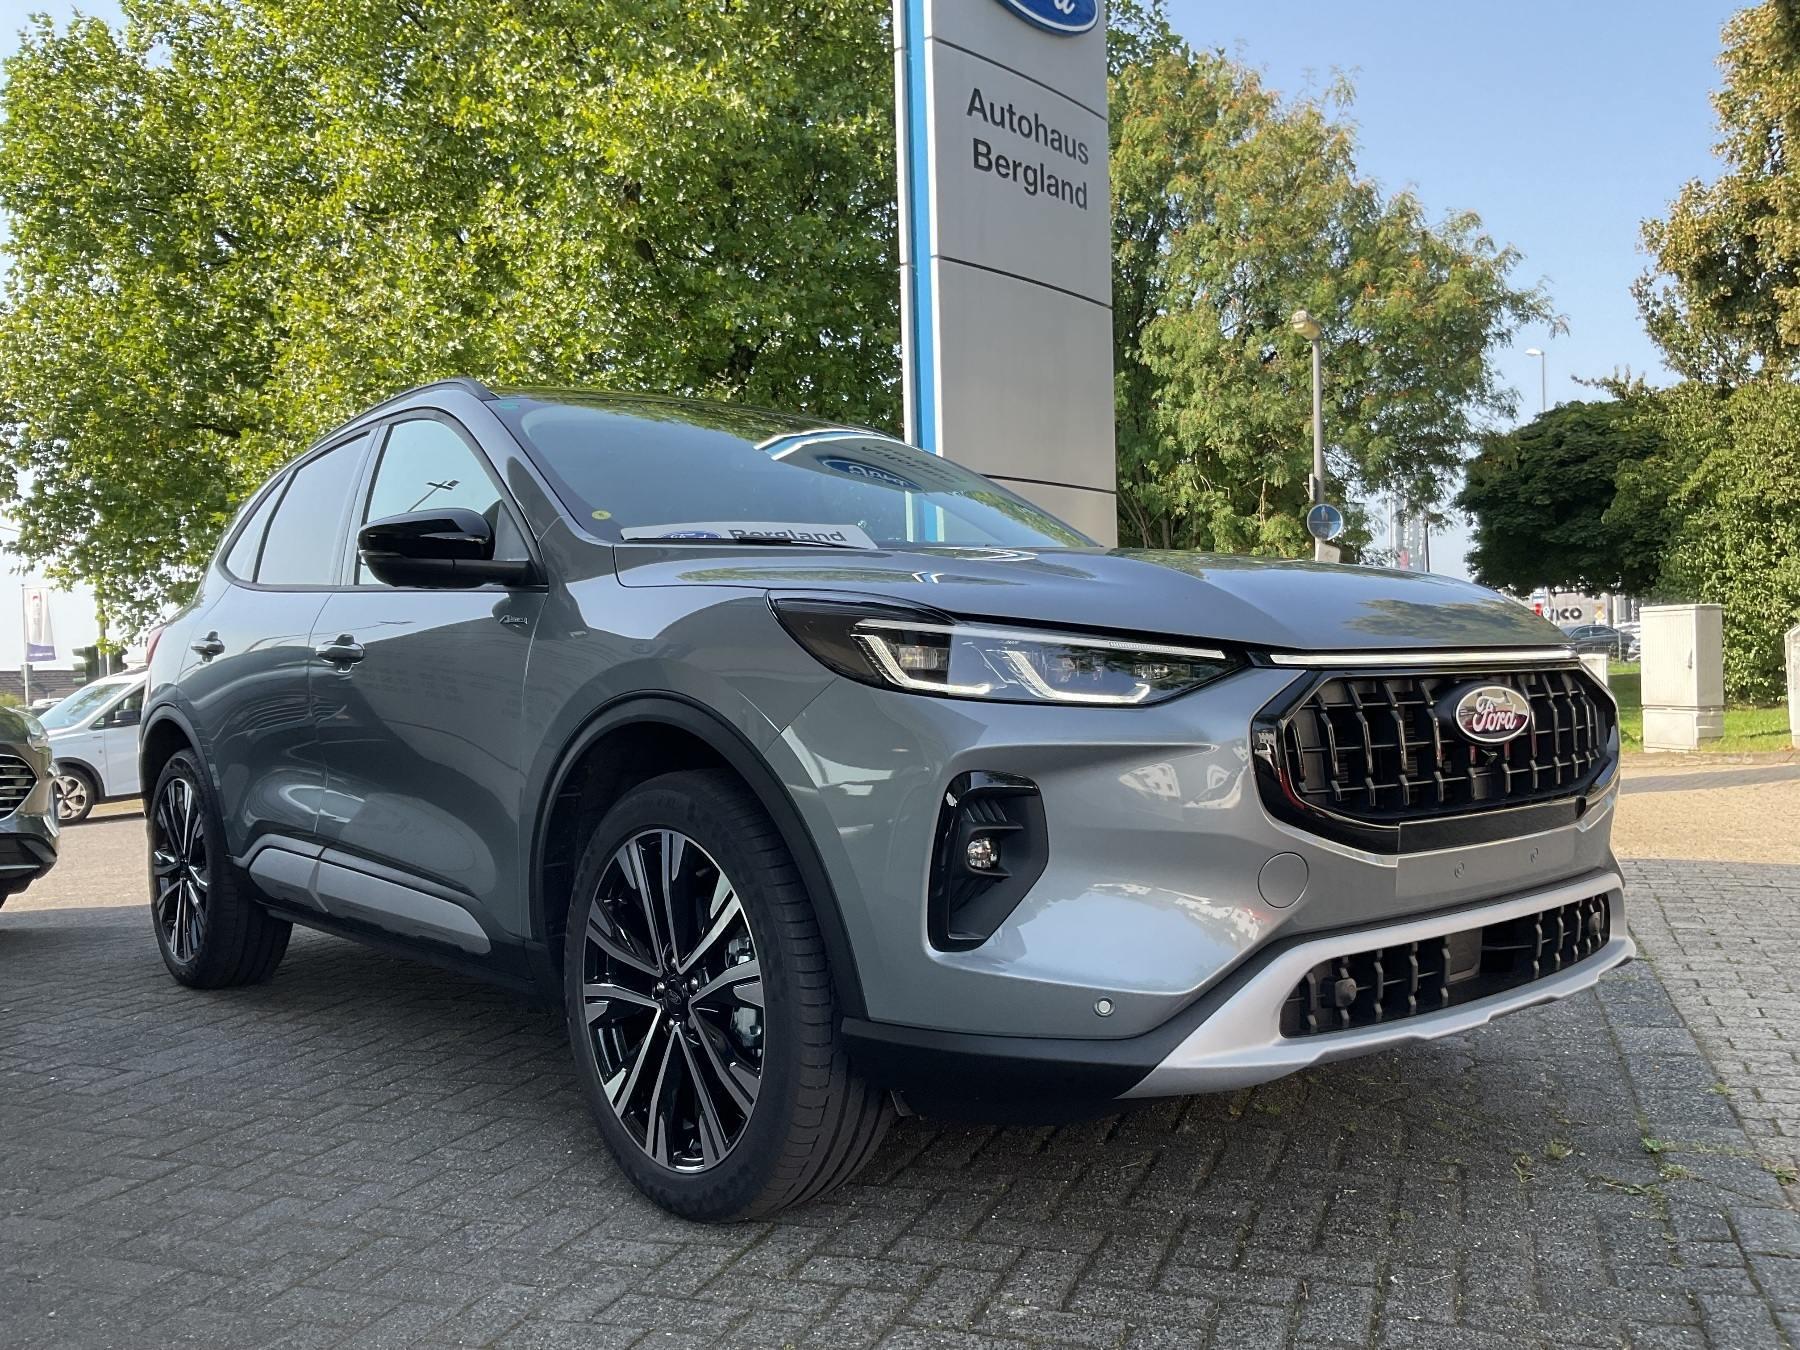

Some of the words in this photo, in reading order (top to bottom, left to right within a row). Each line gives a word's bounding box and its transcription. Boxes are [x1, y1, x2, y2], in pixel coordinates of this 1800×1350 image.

[966, 88, 1089, 165] Autohaus
[972, 137, 1088, 210] Bergland
[1472, 695, 1517, 732] Ford
